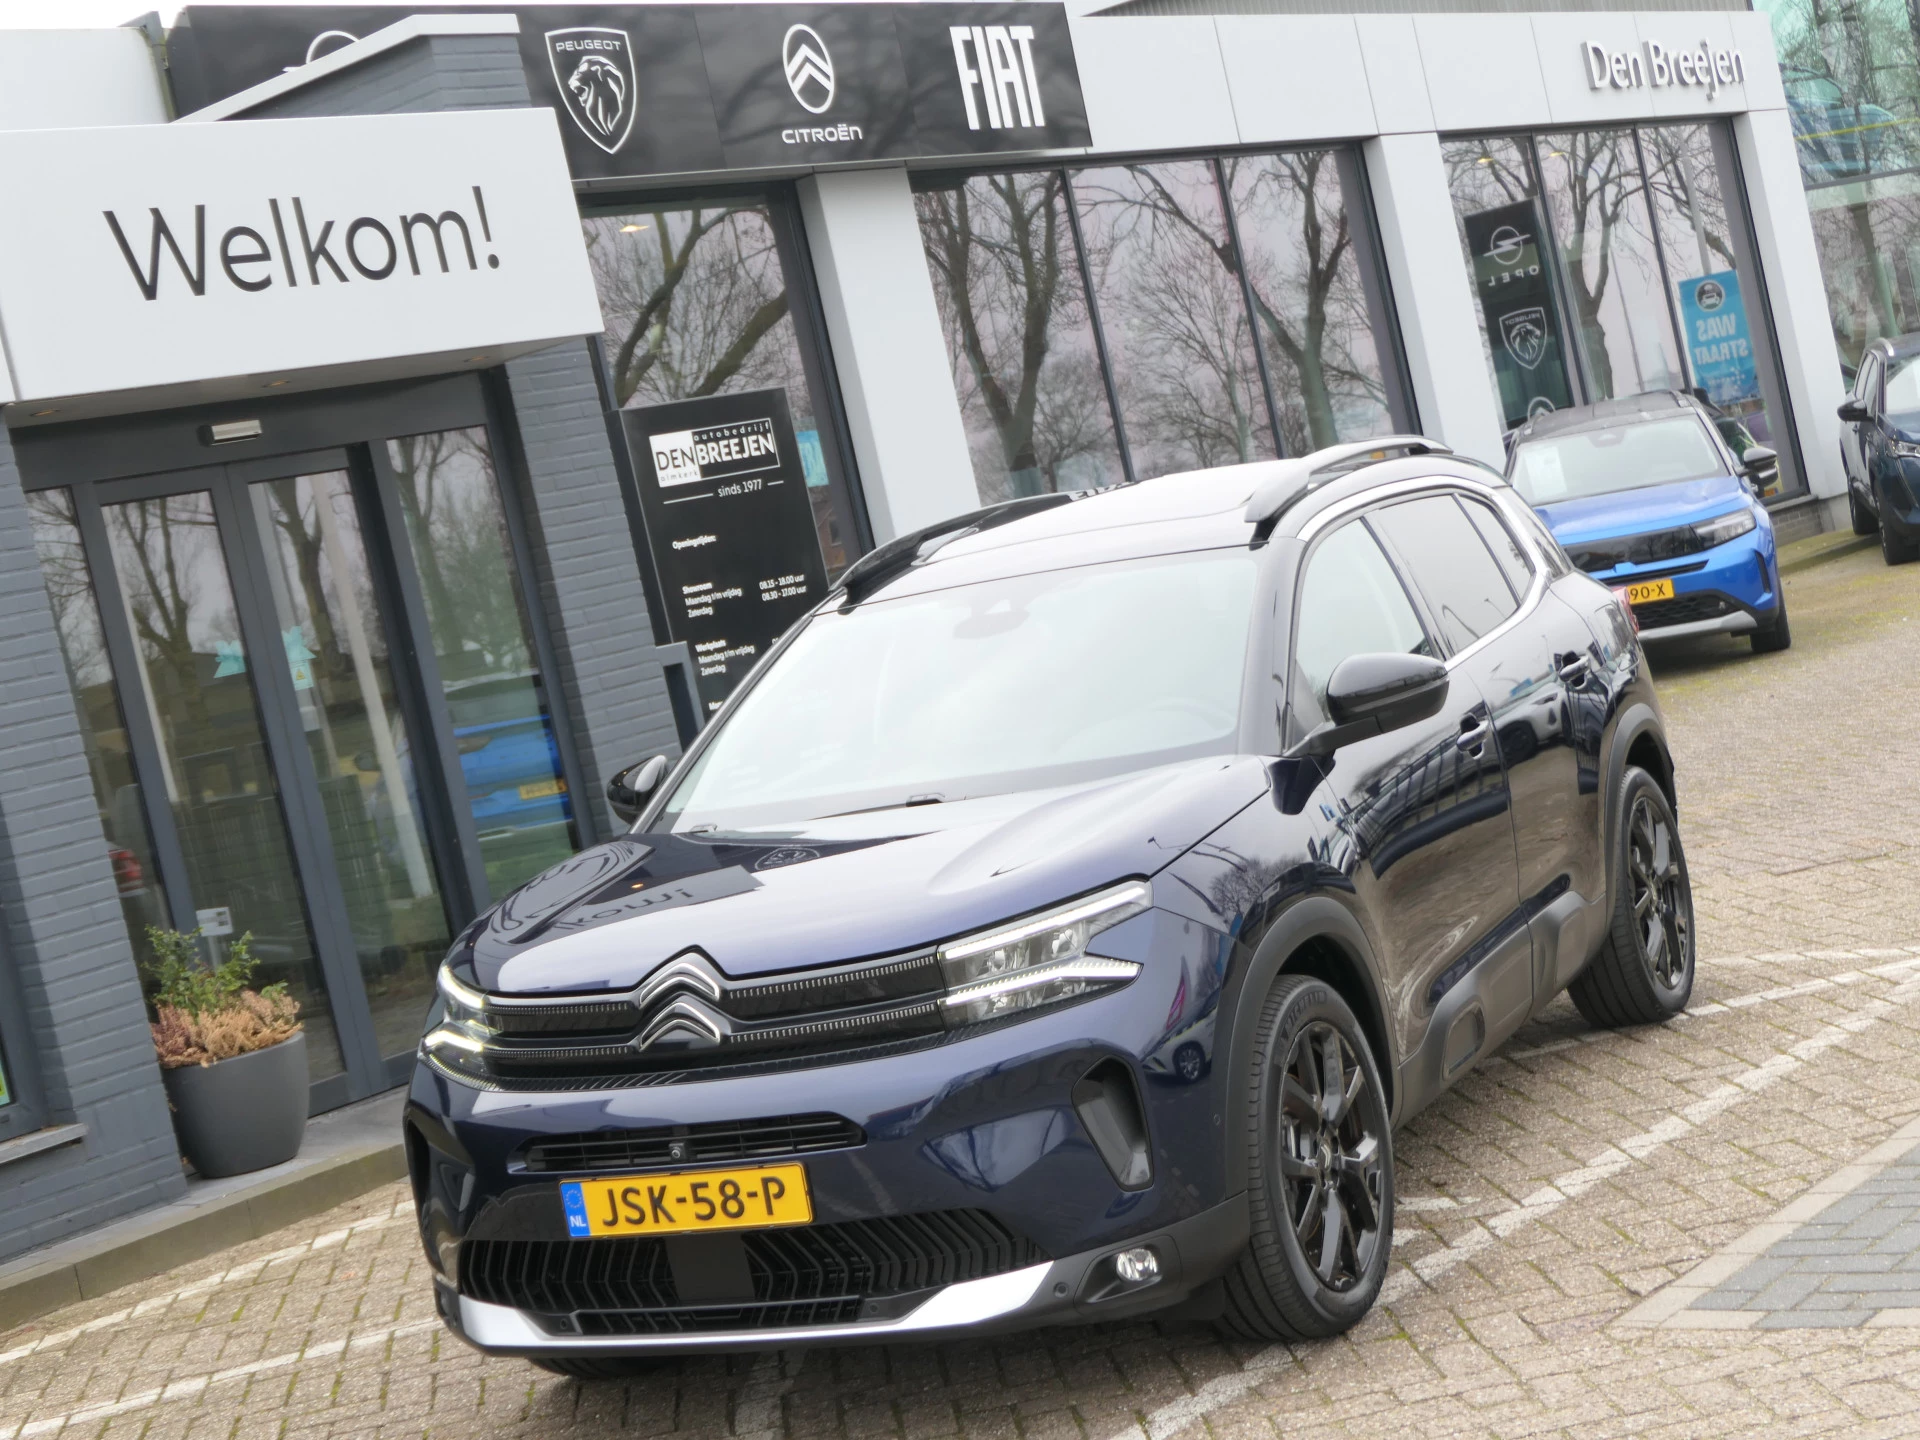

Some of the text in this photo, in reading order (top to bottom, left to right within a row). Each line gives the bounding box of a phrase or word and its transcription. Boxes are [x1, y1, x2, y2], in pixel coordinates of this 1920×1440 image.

[556, 40, 621, 53] PEUGEOT
[949, 26, 1046, 130] FIAT
[1580, 37, 1747, 101] Den Breejen
[782, 124, 863, 144] CITROËN
[102, 186, 500, 301] Welkom!
[693, 421, 769, 442] autobedrijf
[656, 446, 696, 471] DEN
[695, 432, 776, 466] BREEJEN
[717, 478, 763, 498] sinds 1977
[722, 587, 743, 599] vrijdag
[602, 1176, 786, 1227] JSK-58-P
[570, 1215, 587, 1228] NL
